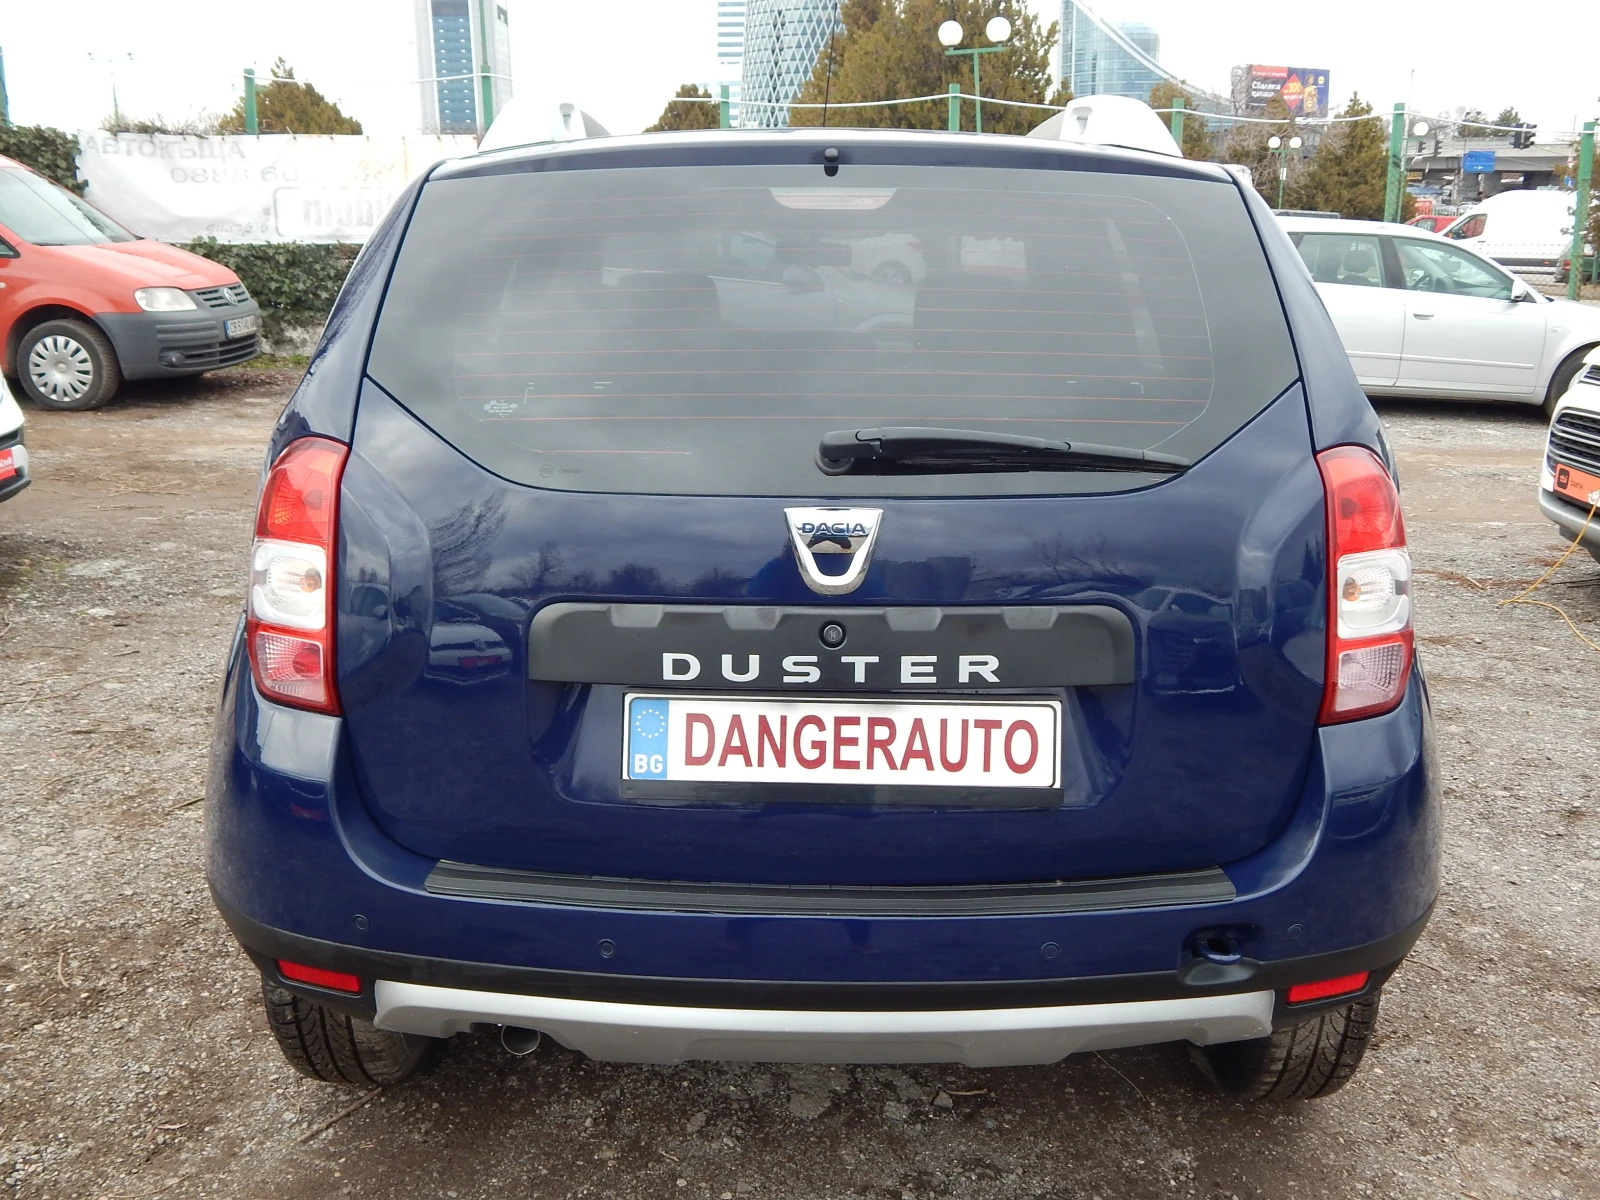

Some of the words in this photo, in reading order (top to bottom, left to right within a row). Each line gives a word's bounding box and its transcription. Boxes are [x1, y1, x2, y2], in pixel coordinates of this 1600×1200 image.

[85, 134, 247, 162] АВТОКЪЩА
[802, 522, 867, 534] DACIA
[662, 652, 1001, 684] DUSTER
[684, 712, 1039, 775] DANGERAUTO
[634, 753, 664, 774] BG
